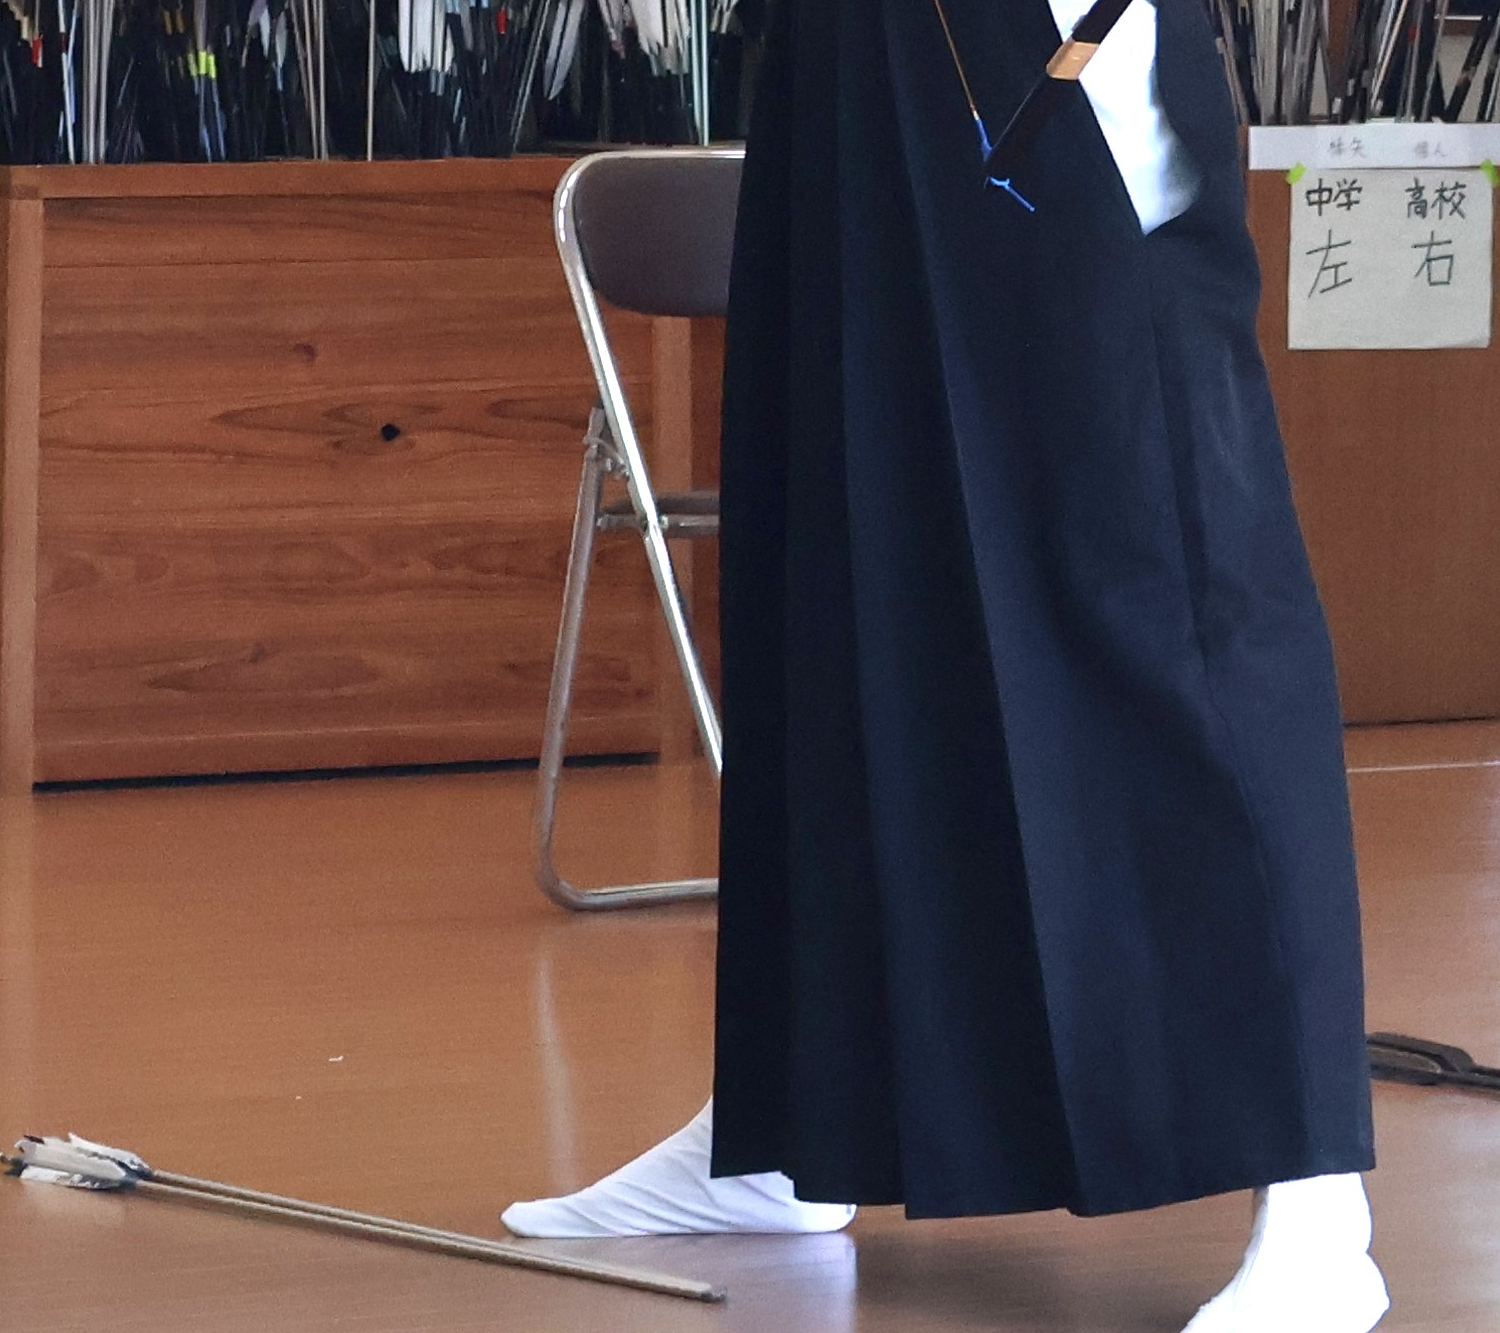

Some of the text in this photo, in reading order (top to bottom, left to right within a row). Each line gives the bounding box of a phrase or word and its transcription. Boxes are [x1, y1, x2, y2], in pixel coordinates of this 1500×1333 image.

[1304, 177, 1468, 221] 中学 高校
[1305, 228, 1454, 299] 左 右
